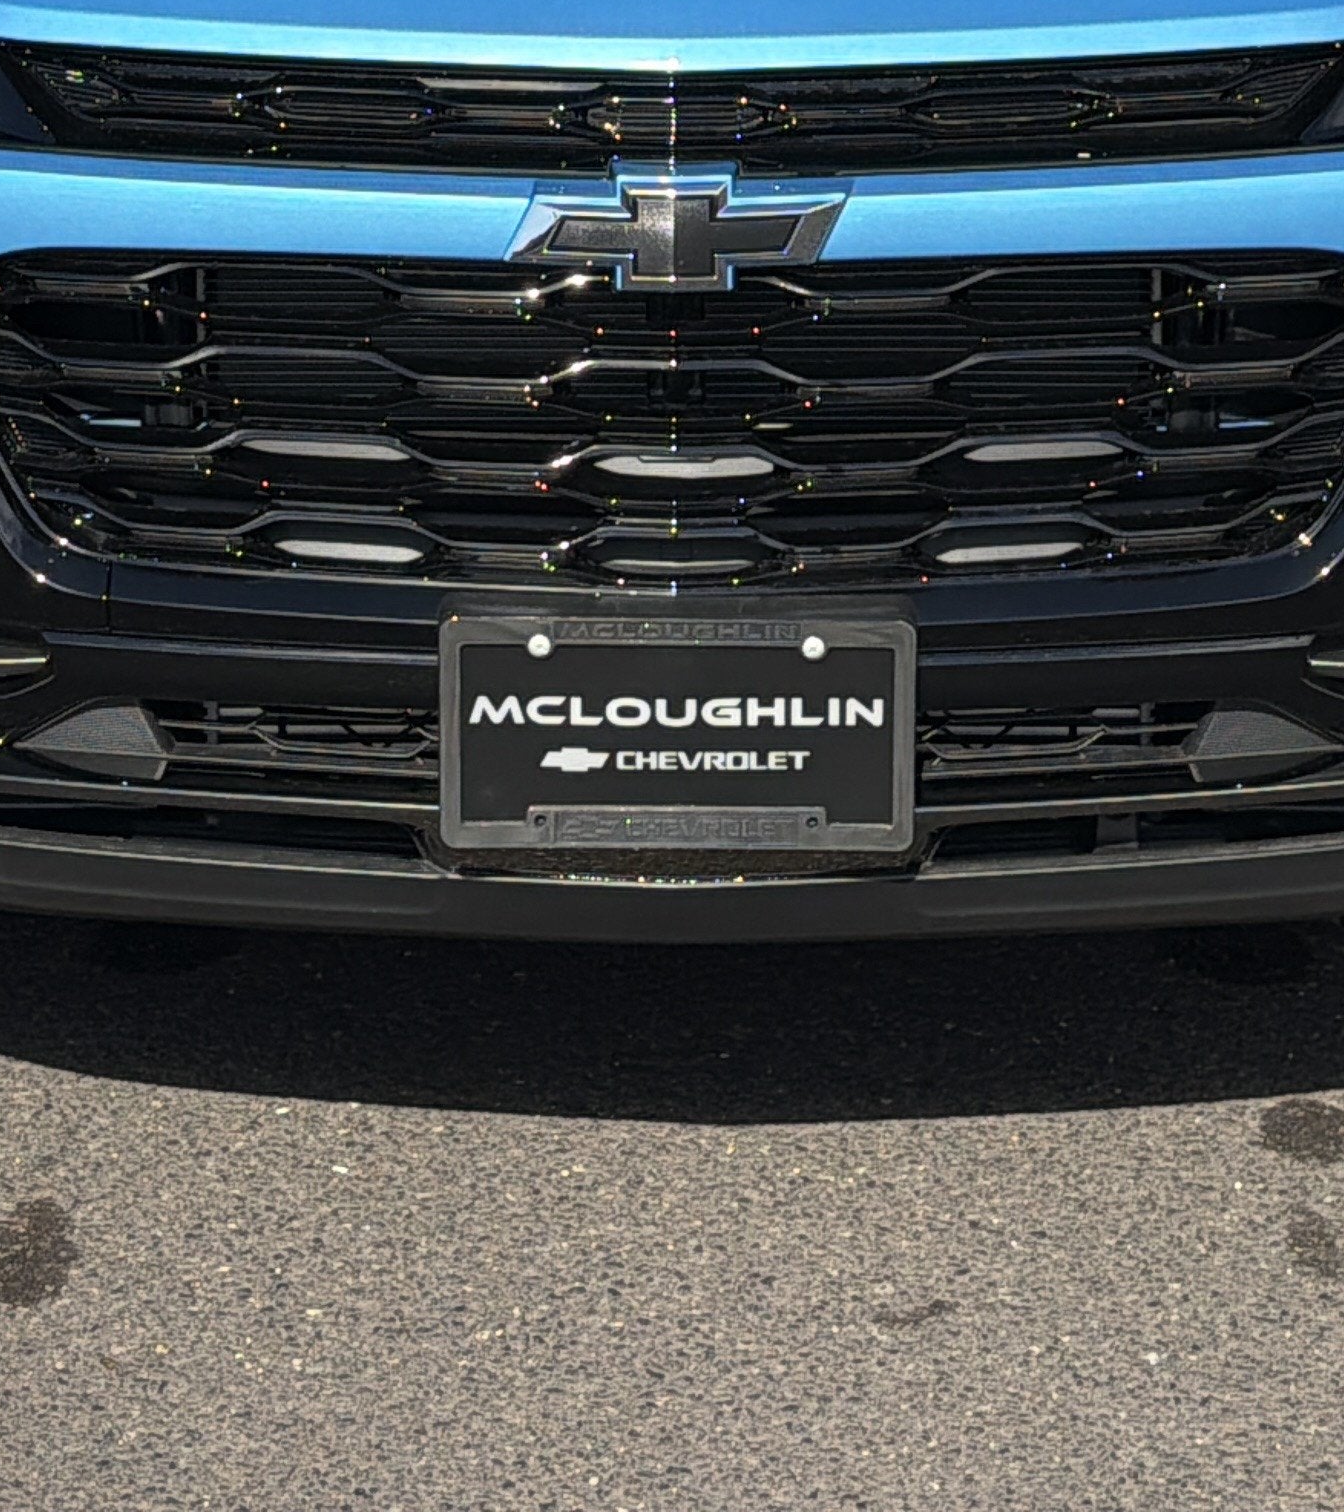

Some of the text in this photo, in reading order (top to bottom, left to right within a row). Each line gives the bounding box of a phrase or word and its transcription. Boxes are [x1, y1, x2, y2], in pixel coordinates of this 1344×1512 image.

[558, 622, 798, 640] MCLOUGHLIN
[469, 695, 885, 728] MCLOUGHLIN
[615, 750, 811, 771] CHEVROLET
[625, 820, 795, 840] CHEVROLET
